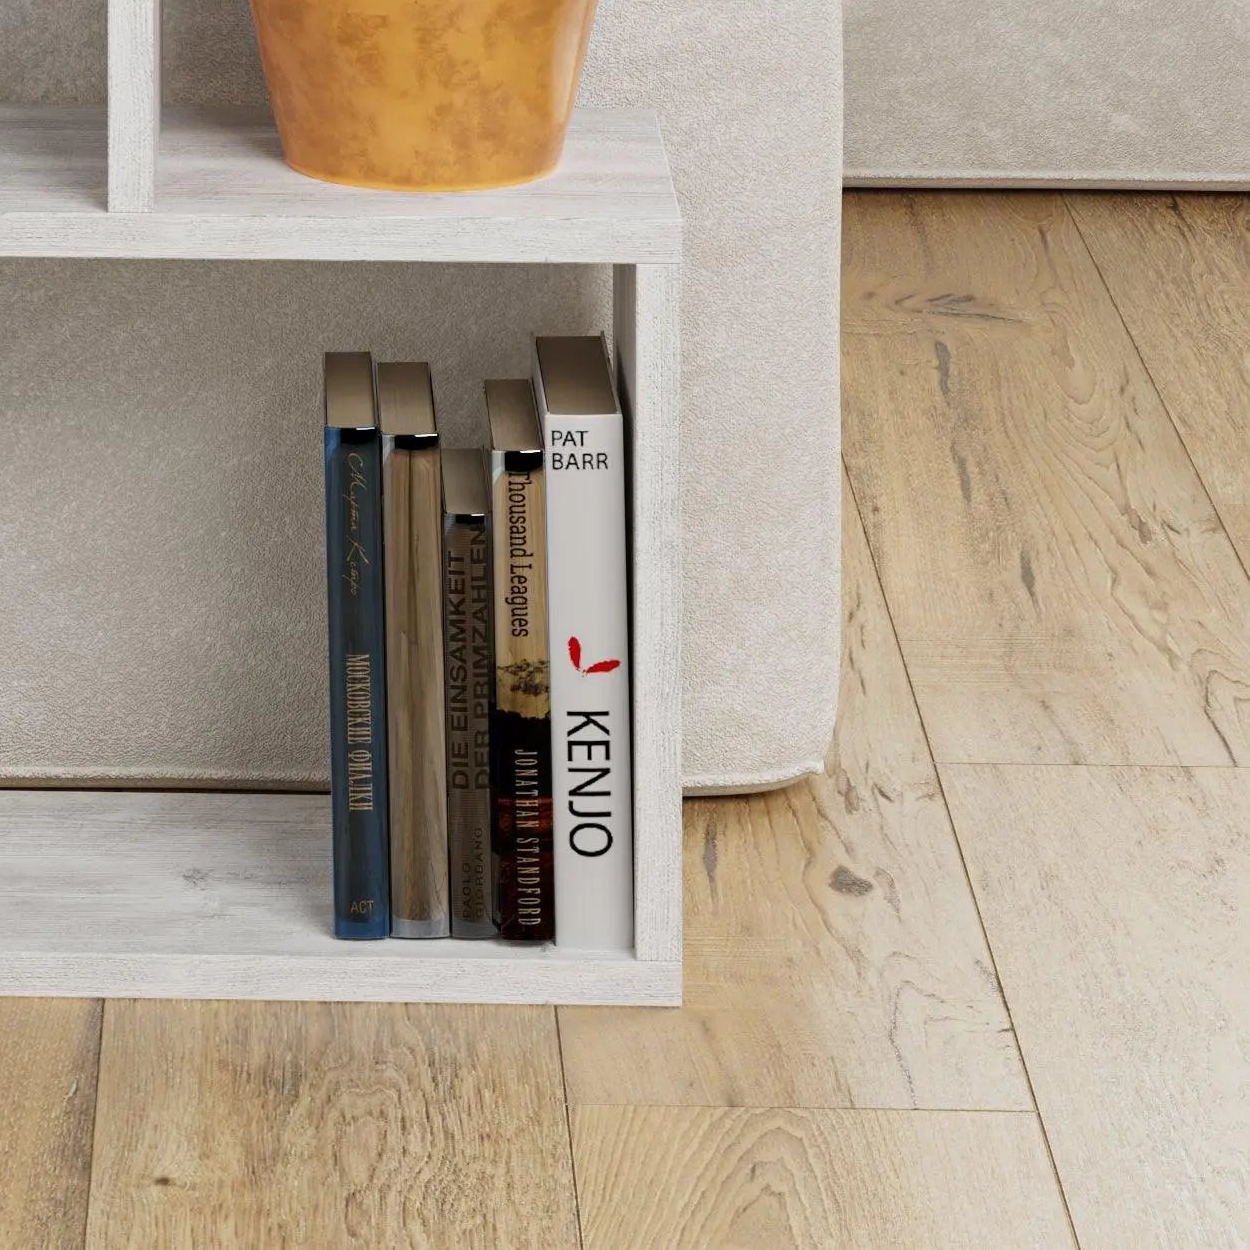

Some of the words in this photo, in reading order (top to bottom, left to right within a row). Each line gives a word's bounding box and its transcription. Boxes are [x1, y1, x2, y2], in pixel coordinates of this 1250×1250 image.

[551, 430, 589, 447] PAT
[553, 453, 608, 470] BARR
[507, 471, 534, 557] Thousand
[470, 528, 488, 718] PRIMZAHLEN
[504, 564, 532, 637] Leagues
[448, 551, 468, 730] EINSAMKEIT
[346, 654, 372, 744] МОСКОВСКИЕ
[347, 749, 374, 812] ФИАЛКИ
[452, 743, 469, 789] DIE
[475, 731, 489, 789] DER
[514, 749, 539, 828] JONATHAN
[566, 711, 613, 857] KENJO
[516, 837, 541, 925] STANDFORD
